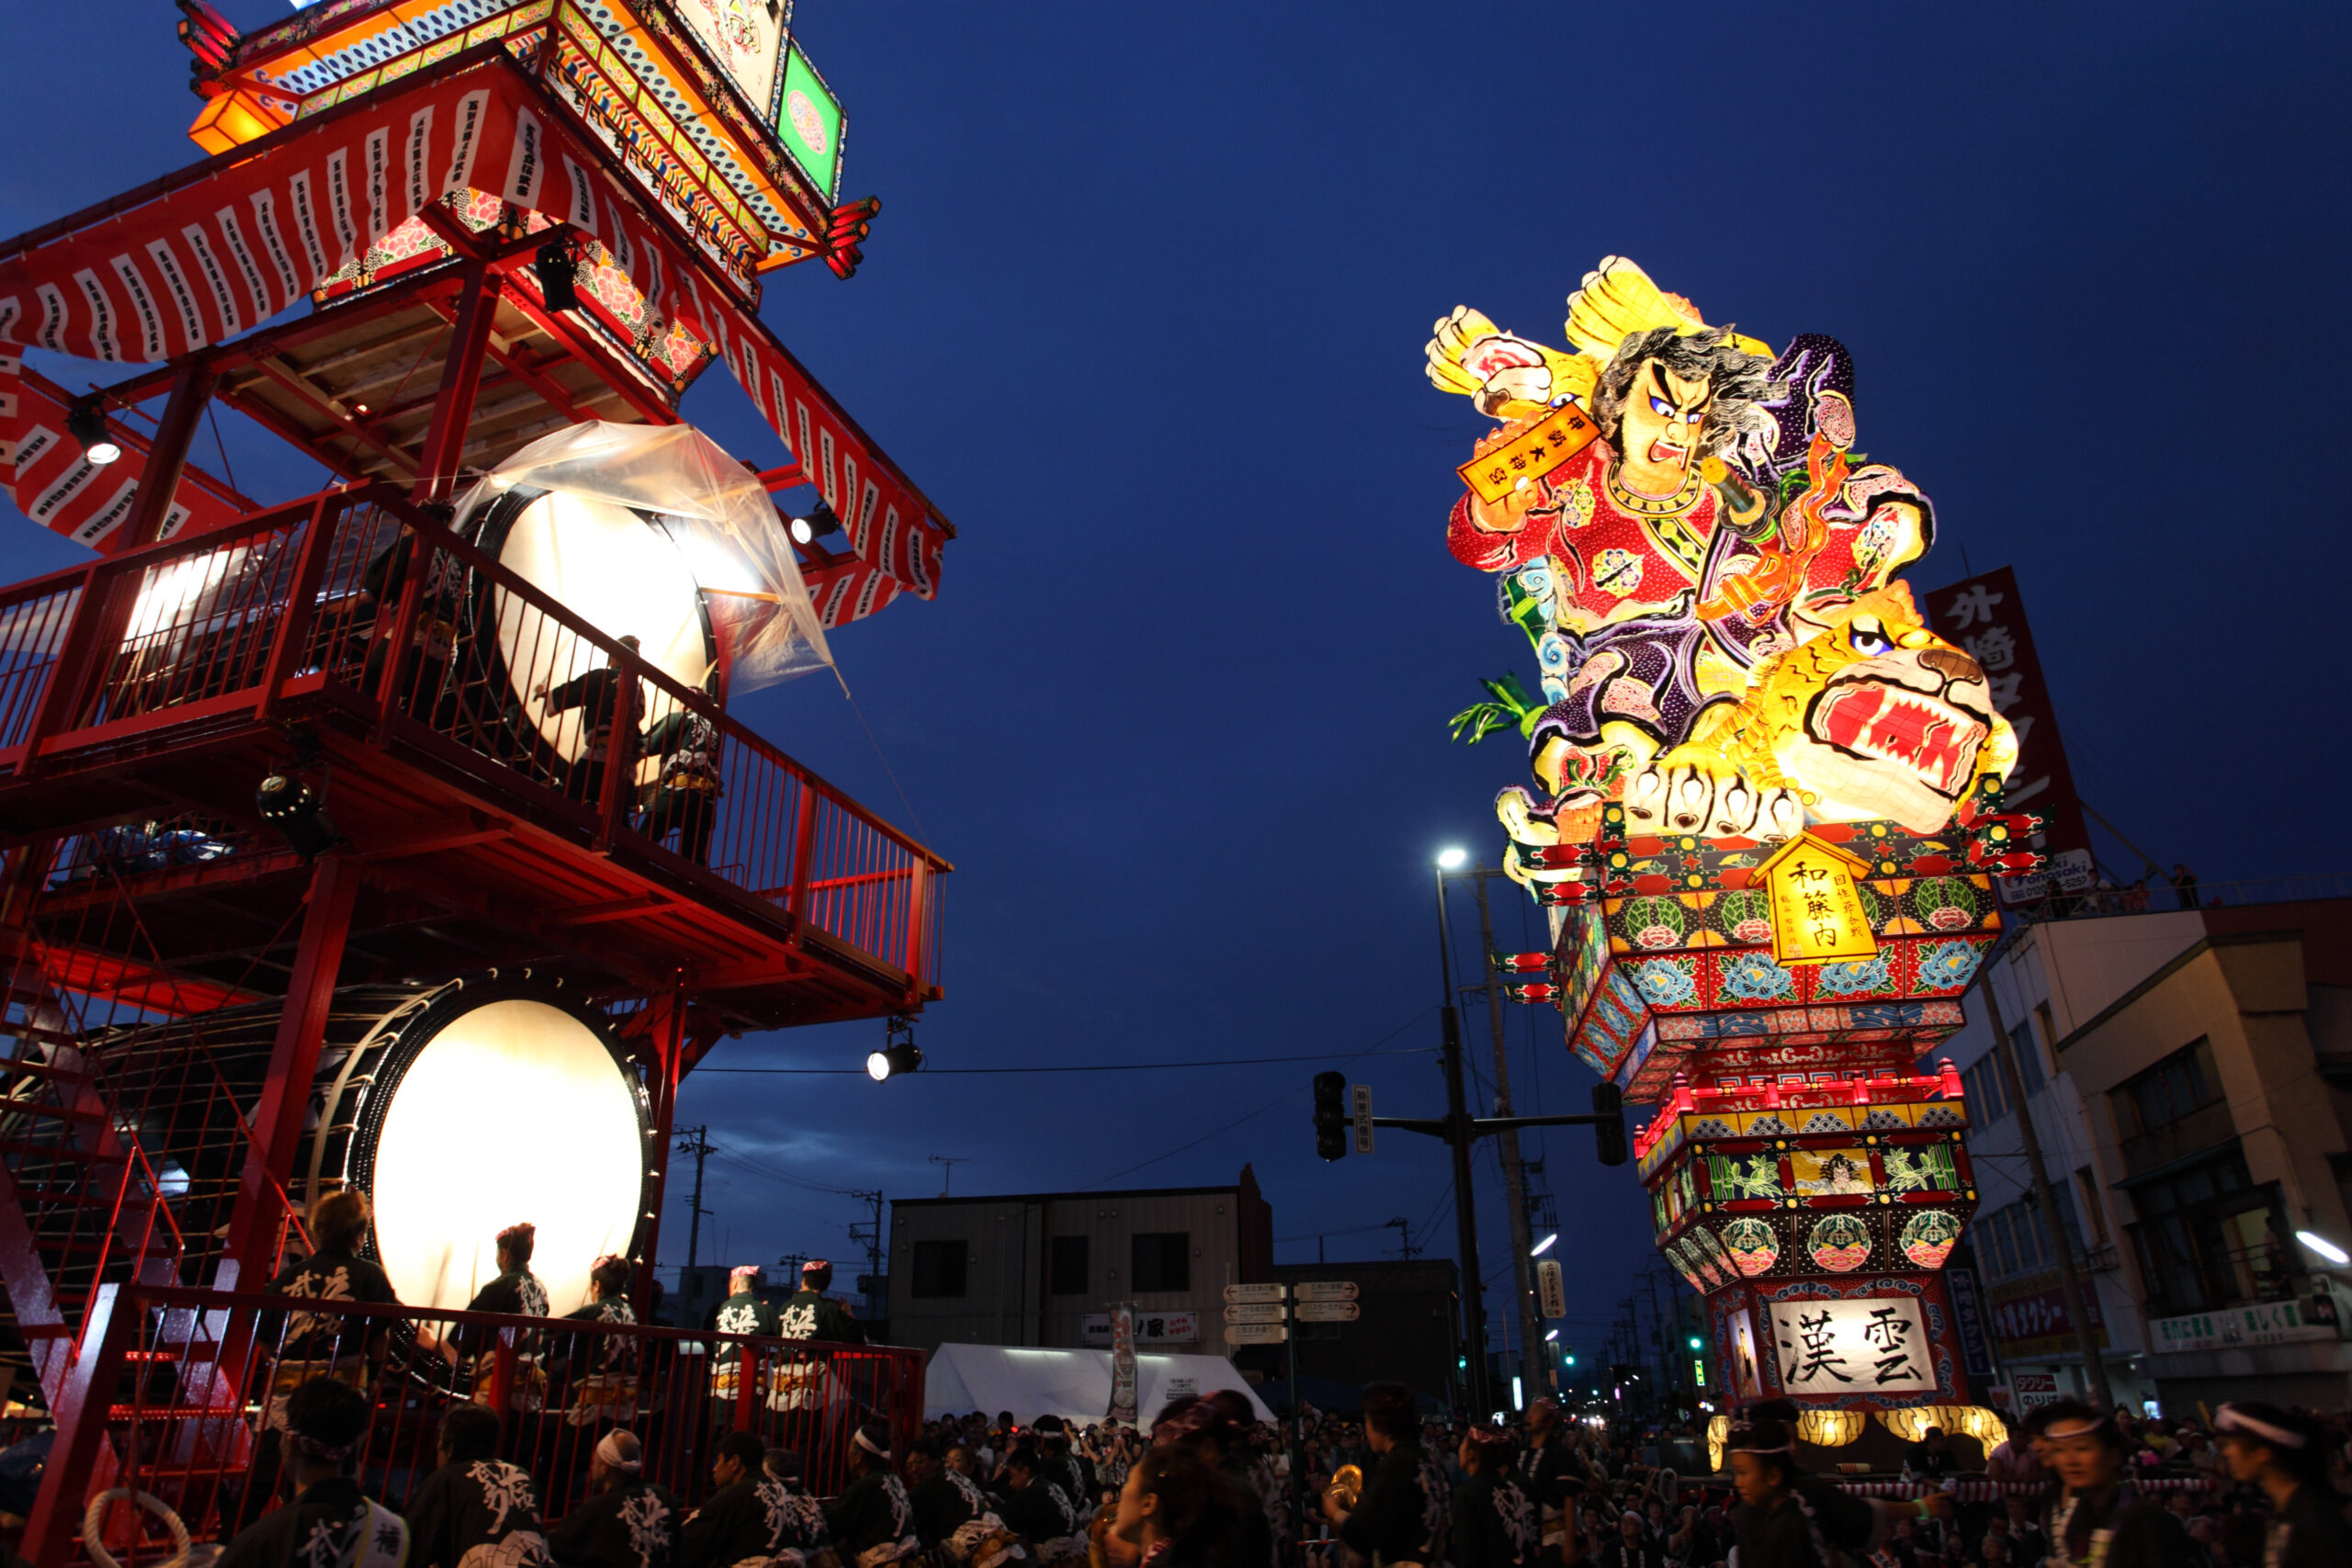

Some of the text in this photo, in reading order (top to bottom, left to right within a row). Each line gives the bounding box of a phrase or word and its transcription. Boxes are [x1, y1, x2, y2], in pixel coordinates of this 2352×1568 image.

[1356, 1090, 1369, 1148] 時差式信号
[2017, 1376, 2055, 1391] タクシー
